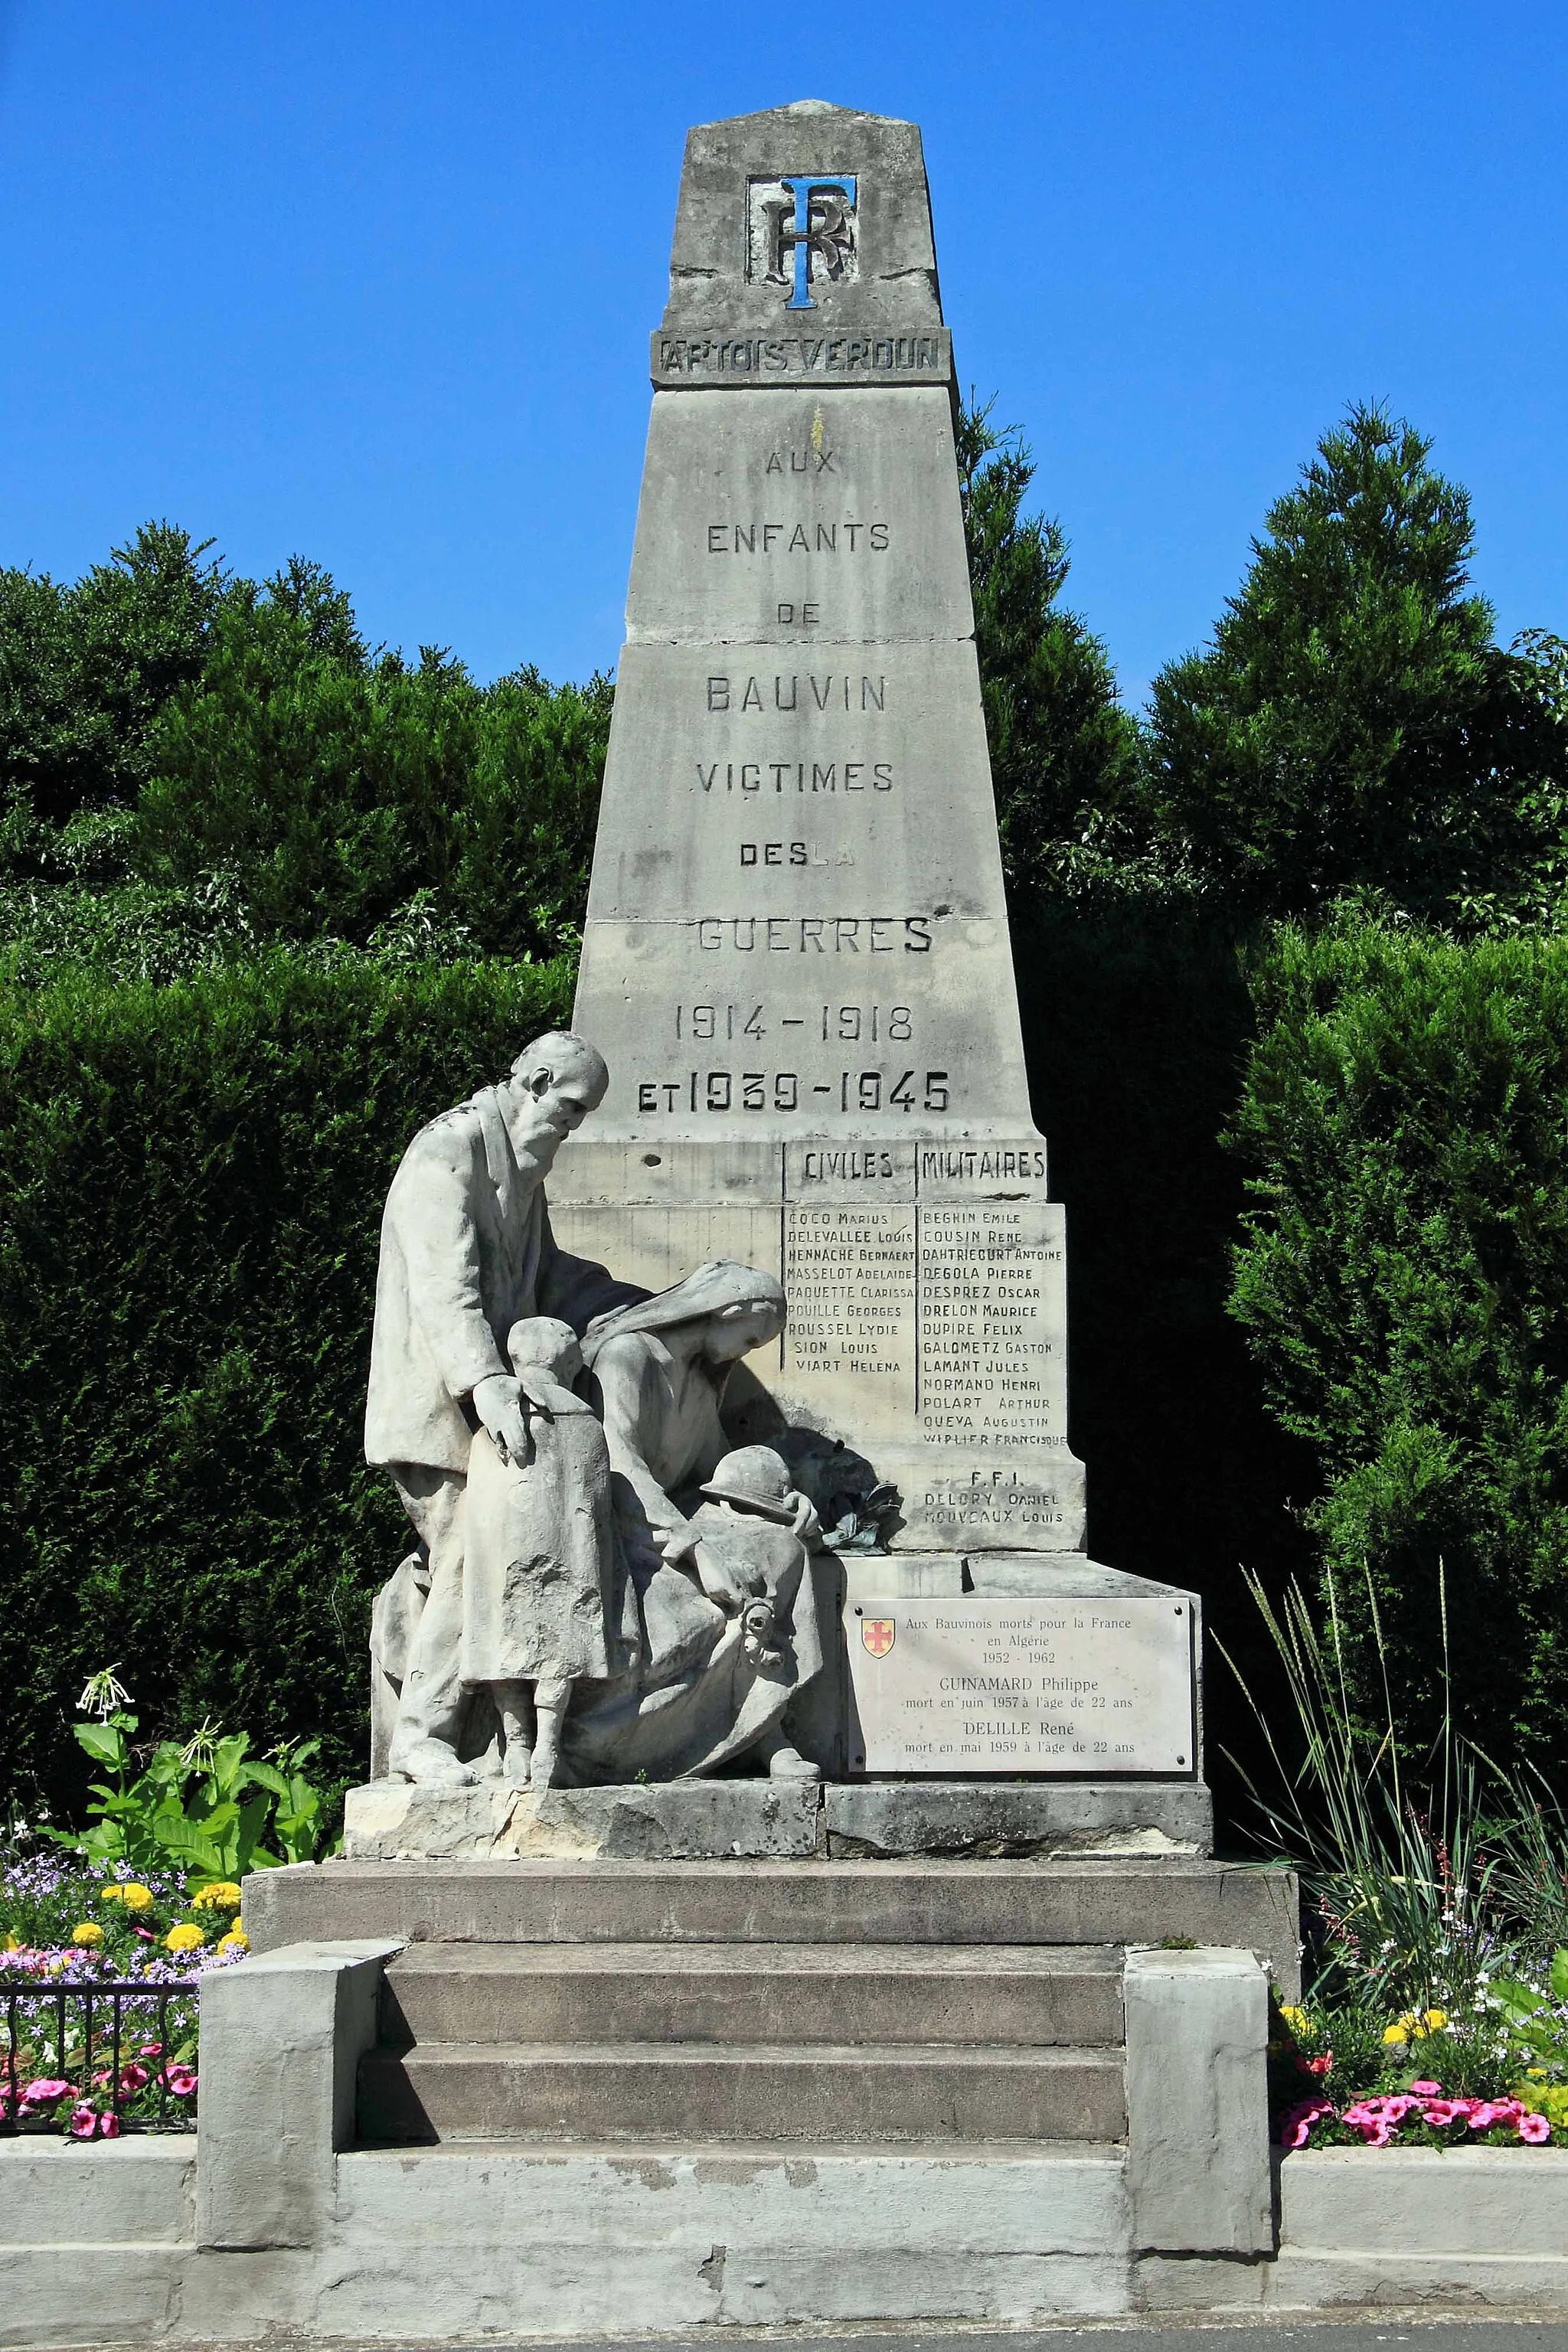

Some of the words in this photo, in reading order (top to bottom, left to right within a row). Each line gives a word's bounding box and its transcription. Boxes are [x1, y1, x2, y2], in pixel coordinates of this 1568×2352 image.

[799, 338, 939, 371] VERDUN
[766, 452, 835, 475] AUX
[708, 524, 890, 553] ENFANTS
[778, 603, 820, 624] DE
[707, 676, 886, 711] BAUVIN
[696, 763, 893, 792] VICTIMES
[740, 842, 807, 866] DES
[699, 917, 932, 953] GUERRES
[677, 1005, 766, 1040] 1914
[822, 1005, 912, 1041] 1918
[639, 1084, 681, 1112] ET
[691, 1072, 798, 1112] 1939
[841, 1070, 949, 1112] 1945
[805, 1152, 893, 1179] CIVILES
[923, 1151, 1044, 1179] MILITAIRES
[789, 1213, 830, 1224] COCO
[838, 1213, 888, 1224] MARIUS
[923, 1213, 975, 1223] BEGHIN
[878, 1231, 913, 1243] LOUIS
[924, 1231, 980, 1243] COUSIN
[789, 1250, 854, 1261] HENNACHE
[860, 1250, 914, 1261] BERNAERT
[1014, 1249, 1062, 1260] ANTOINE
[787, 1268, 852, 1279] MASSELOT
[923, 1268, 979, 1279] DEGOLA
[988, 1268, 1032, 1279] PIERRE
[787, 1286, 854, 1302] PAQUETTE
[861, 1286, 913, 1298] CLARISSA
[923, 1286, 990, 1298] DESPREZ
[998, 1286, 1040, 1298] OSCAR
[788, 1305, 840, 1317] POUILLE
[848, 1305, 901, 1317] GEORGES
[923, 1305, 977, 1317] DRELON
[983, 1305, 1037, 1317] MAURICE
[789, 1323, 852, 1335] ROUSSEL
[859, 1323, 898, 1335] LYDIE
[923, 1323, 975, 1335] DUPIRE
[794, 1342, 827, 1354] SION
[841, 1342, 877, 1354] LOUIS
[923, 1342, 999, 1354] GALOMETZ
[1006, 1342, 1052, 1354] GASTON
[796, 1361, 841, 1373] VIART
[924, 1361, 979, 1372] LAMANT
[986, 1361, 1029, 1372] JULES
[924, 1379, 993, 1391] NORMAND
[1002, 1379, 1040, 1391] HENRI
[923, 1397, 982, 1409] POLART
[999, 1397, 1050, 1409] ARTHUR
[924, 1416, 972, 1429] QUEVA
[983, 1416, 1048, 1428] AUGUSTIN
[995, 1434, 1067, 1448] FRANCISQUE
[972, 1472, 1024, 1486] F.F.I.
[925, 1493, 991, 1506] DELORY
[1008, 1493, 1059, 1506] DANIEL
[1022, 1511, 1063, 1522] LOUIS
[906, 1619, 928, 1629] Aux
[936, 1618, 991, 1629] Bauvinois
[999, 1619, 1032, 1629] morts
[1039, 1620, 1067, 1632] pour
[1074, 1618, 1084, 1628] la
[1092, 1618, 1131, 1628] France
[1009, 1635, 1050, 1648] Algérie
[982, 1652, 1010, 1663] 1952
[1028, 1652, 1056, 1663] 1962
[939, 1677, 1032, 1690] GUINAMARD
[1041, 1677, 1098, 1694] Philippe
[906, 1697, 933, 1708] mort
[941, 1700, 954, 1708] en
[961, 1697, 984, 1710] juin
[992, 1697, 1018, 1708] 1957
[1023, 1697, 1029, 1708] à
[1070, 1697, 1084, 1708] de
[1092, 1697, 1106, 1708] 22
[1113, 1700, 1132, 1708] ans
[964, 1722, 1031, 1735] DELILLE
[1040, 1722, 1074, 1735] René
[905, 1743, 933, 1753] mort
[939, 1744, 953, 1753] en
[961, 1742, 981, 1753] mai
[990, 1742, 1017, 1753] 1959
[1024, 1742, 1031, 1753] à
[1072, 1742, 1086, 1753] de
[1093, 1742, 1107, 1753] 22
[1115, 1744, 1135, 1753] ans
